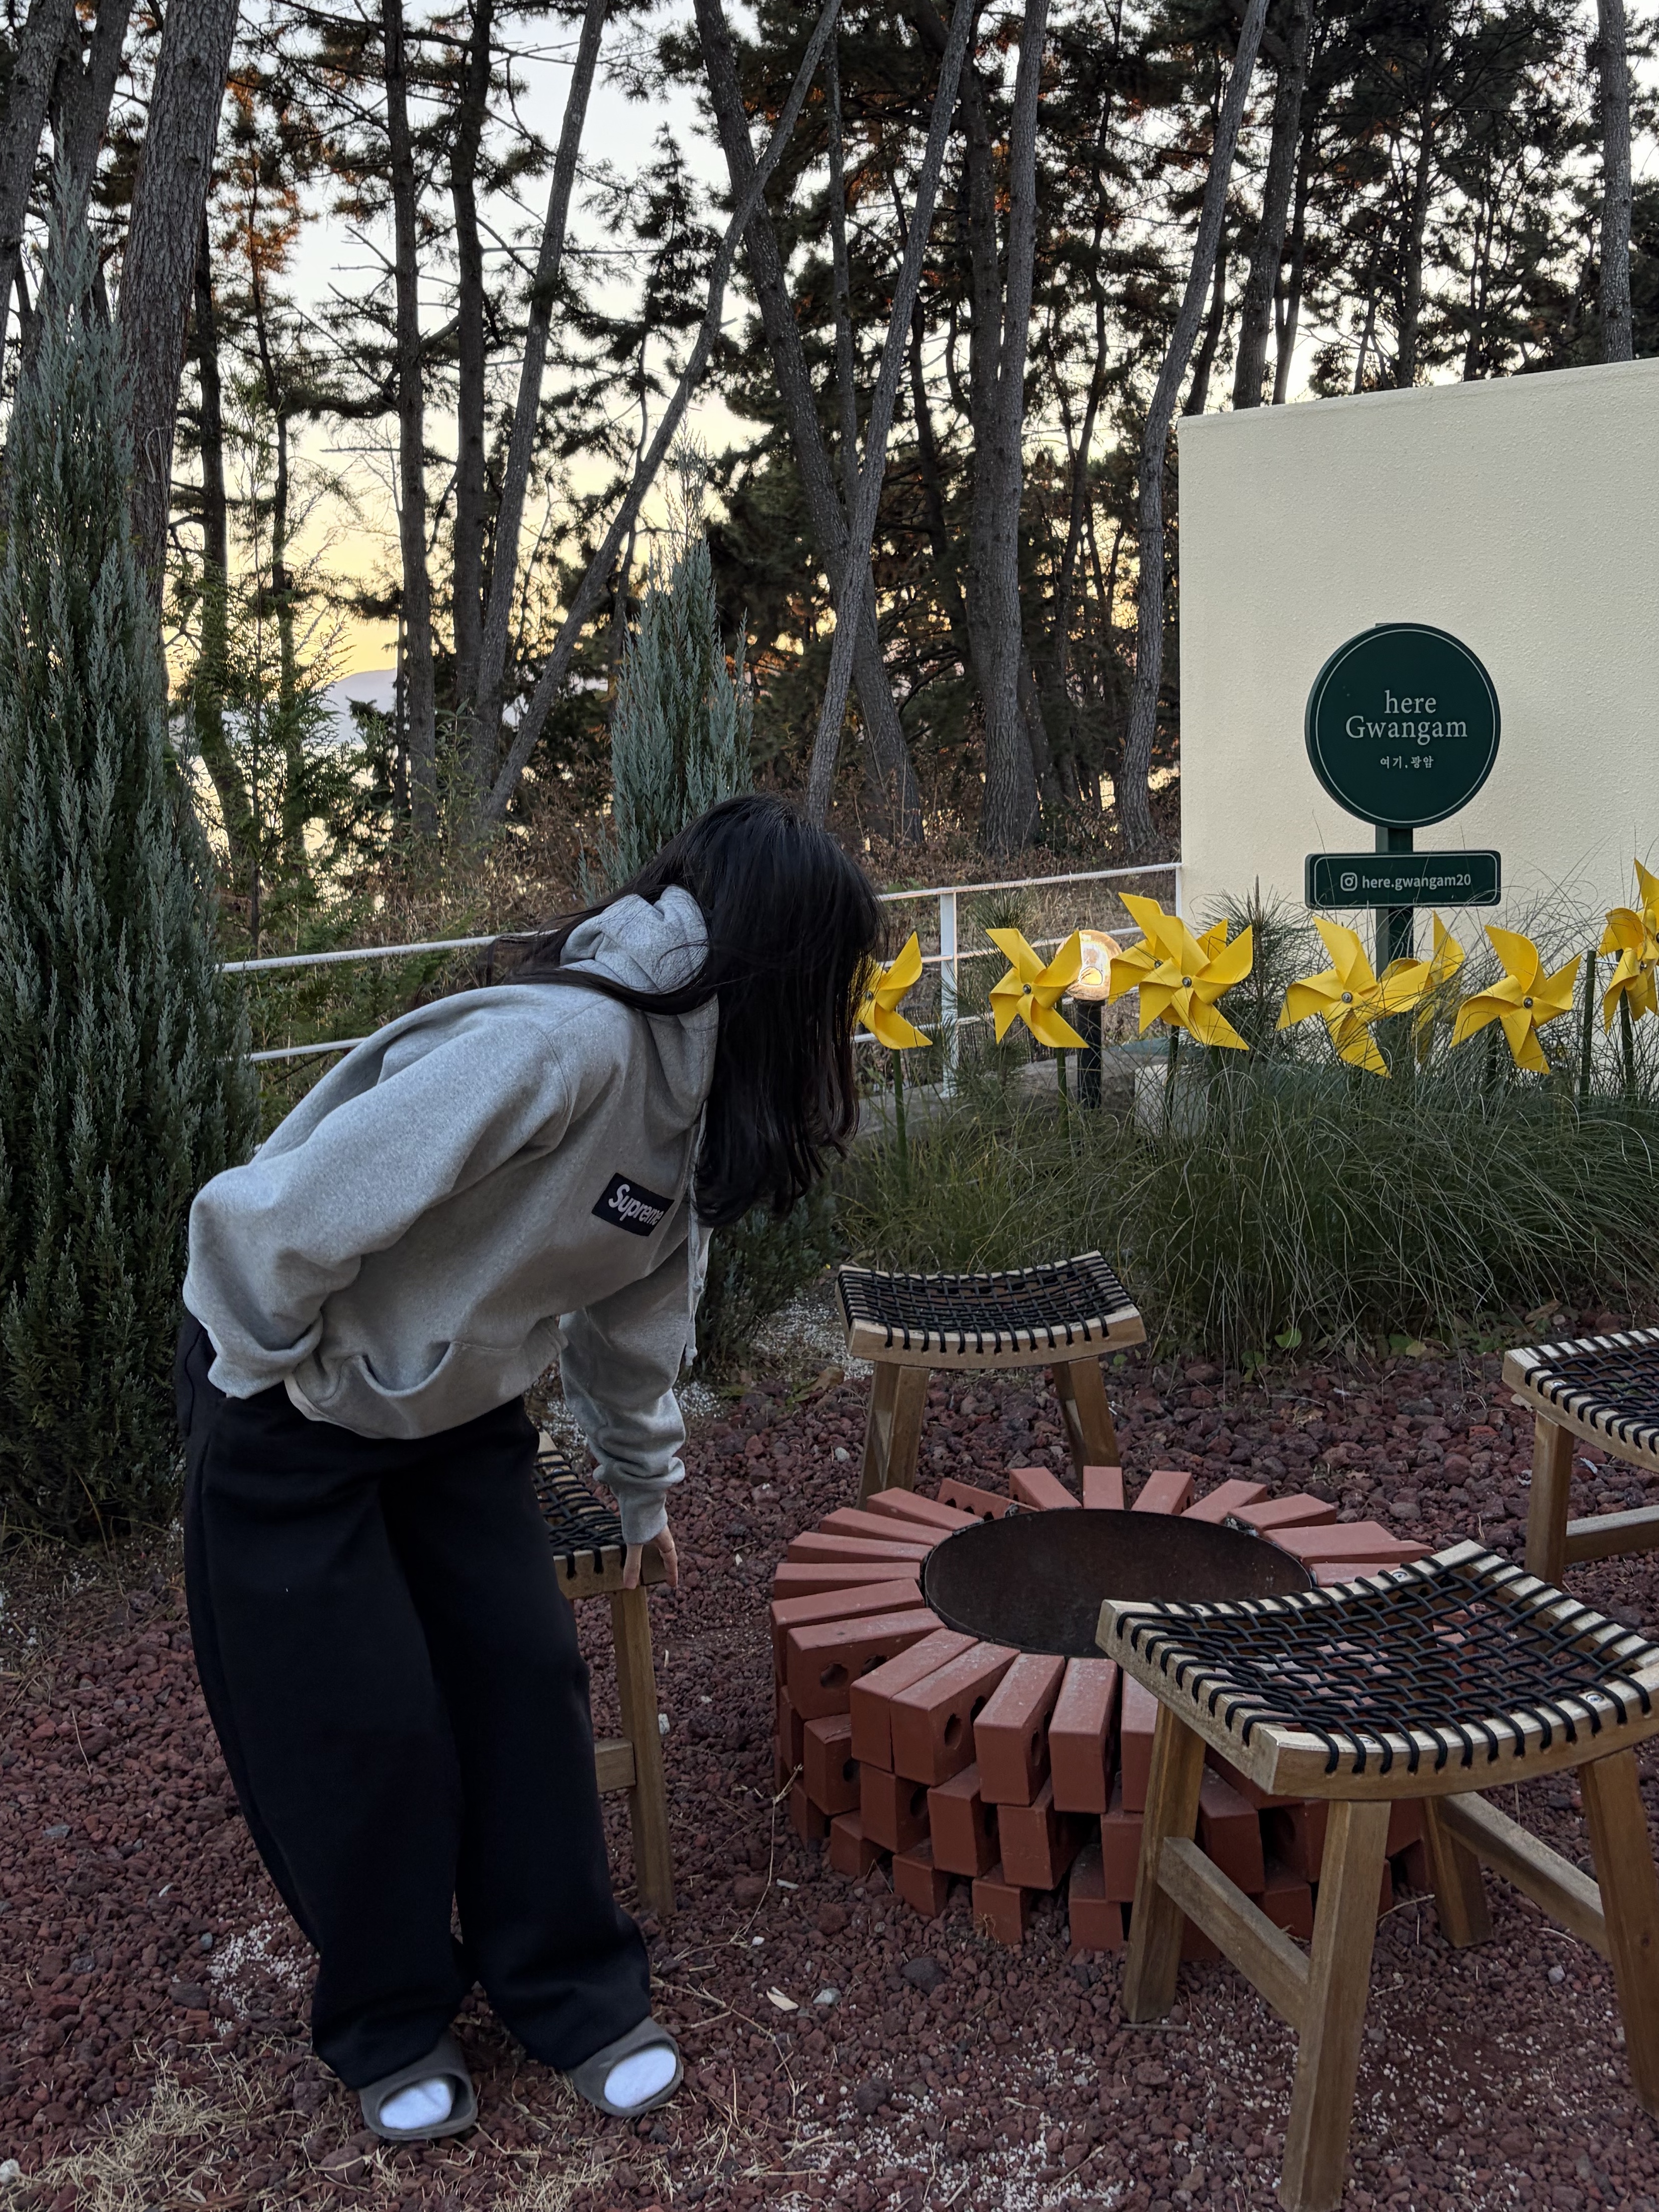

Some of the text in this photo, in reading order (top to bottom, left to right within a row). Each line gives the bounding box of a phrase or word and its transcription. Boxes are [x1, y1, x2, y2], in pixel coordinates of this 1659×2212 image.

[1384, 690, 1436, 714] here
[1346, 716, 1467, 745] Gwangam
[1362, 874, 1471, 891] here.gwangam20
[608, 1184, 664, 1226] Supreme
